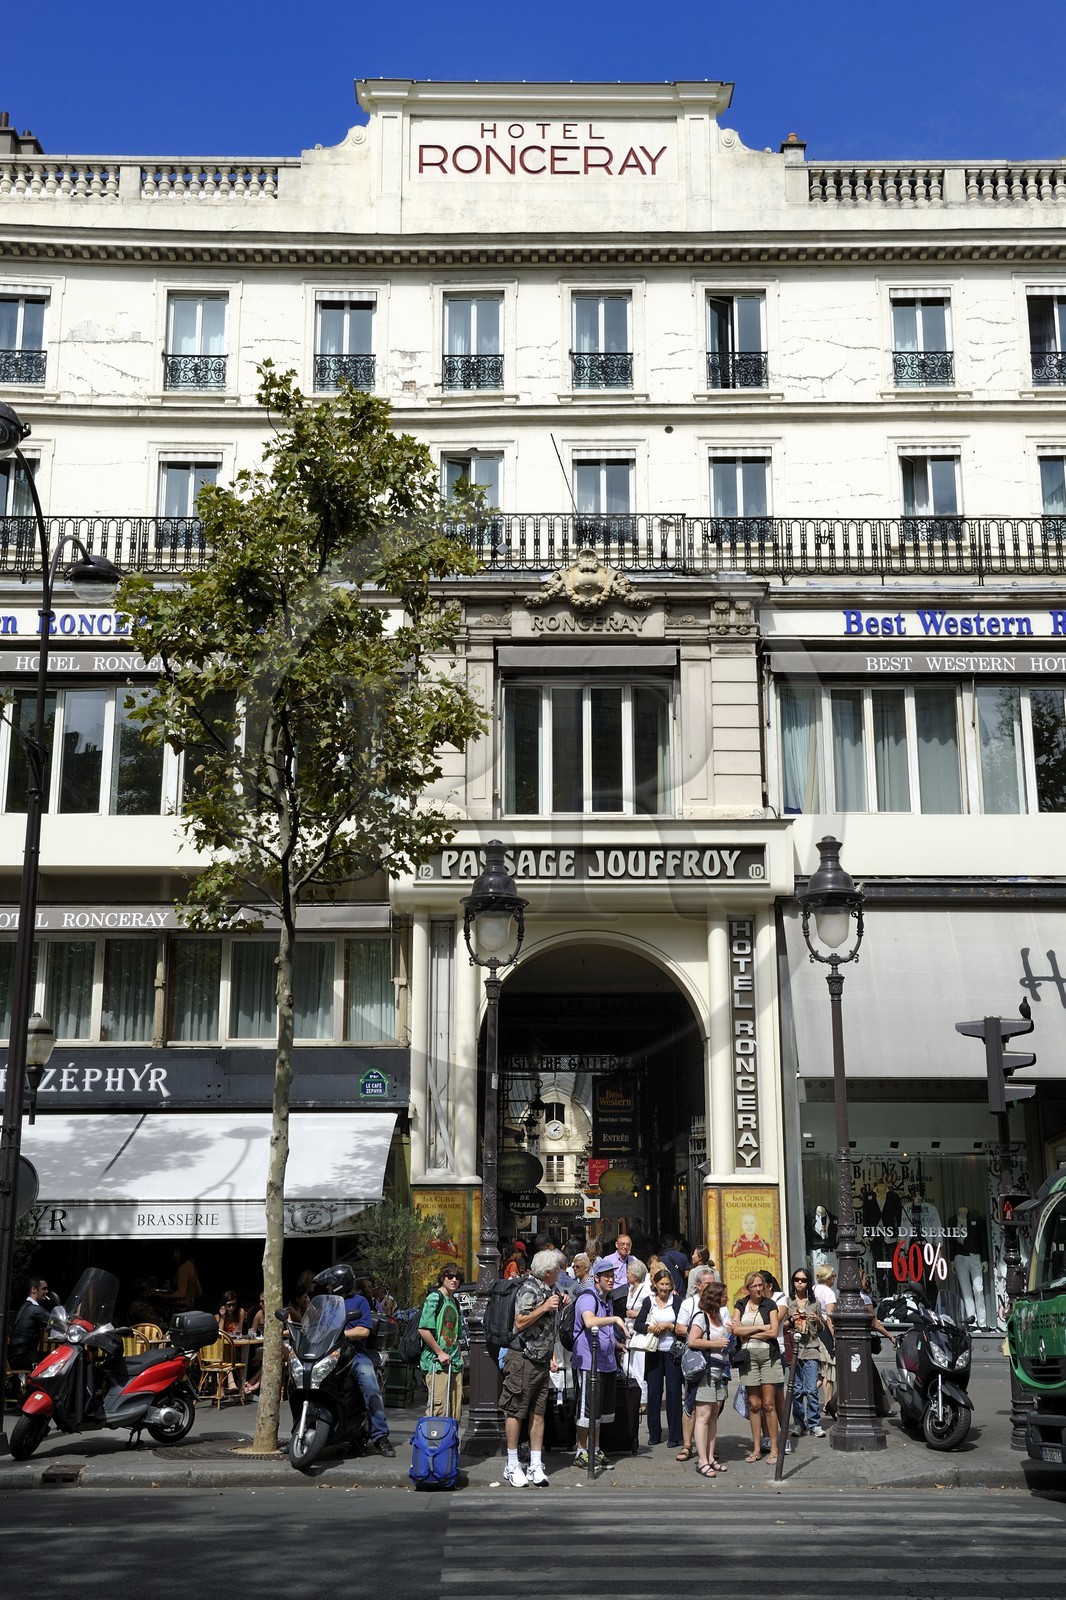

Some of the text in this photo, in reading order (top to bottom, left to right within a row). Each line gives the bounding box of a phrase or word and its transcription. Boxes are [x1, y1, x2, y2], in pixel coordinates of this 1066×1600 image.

[480, 123, 605, 139] HOTEL
[418, 145, 668, 176] RONCERAY
[531, 615, 648, 632] RONCERAY
[843, 610, 906, 635] Best
[917, 610, 1034, 635] Western
[865, 657, 912, 671] BEST
[926, 657, 1016, 671] WESTERN
[441, 850, 741, 877] PASAGE JOUFFROY
[419, 866, 431, 878] 12
[751, 866, 764, 878] 10
[0, 912, 49, 928] OTL
[62, 912, 170, 927] RONCERAY
[732, 921, 758, 1167] HOTEL RONCERAY
[37, 1062, 171, 1098] ZÉPHYR
[599, 1097, 632, 1106] Western
[605, 1090, 624, 1098] Best
[744, 1194, 765, 1202] CURE
[137, 1213, 219, 1227] BRASSERIE
[863, 1226, 968, 1238] FINS DE SERIES
